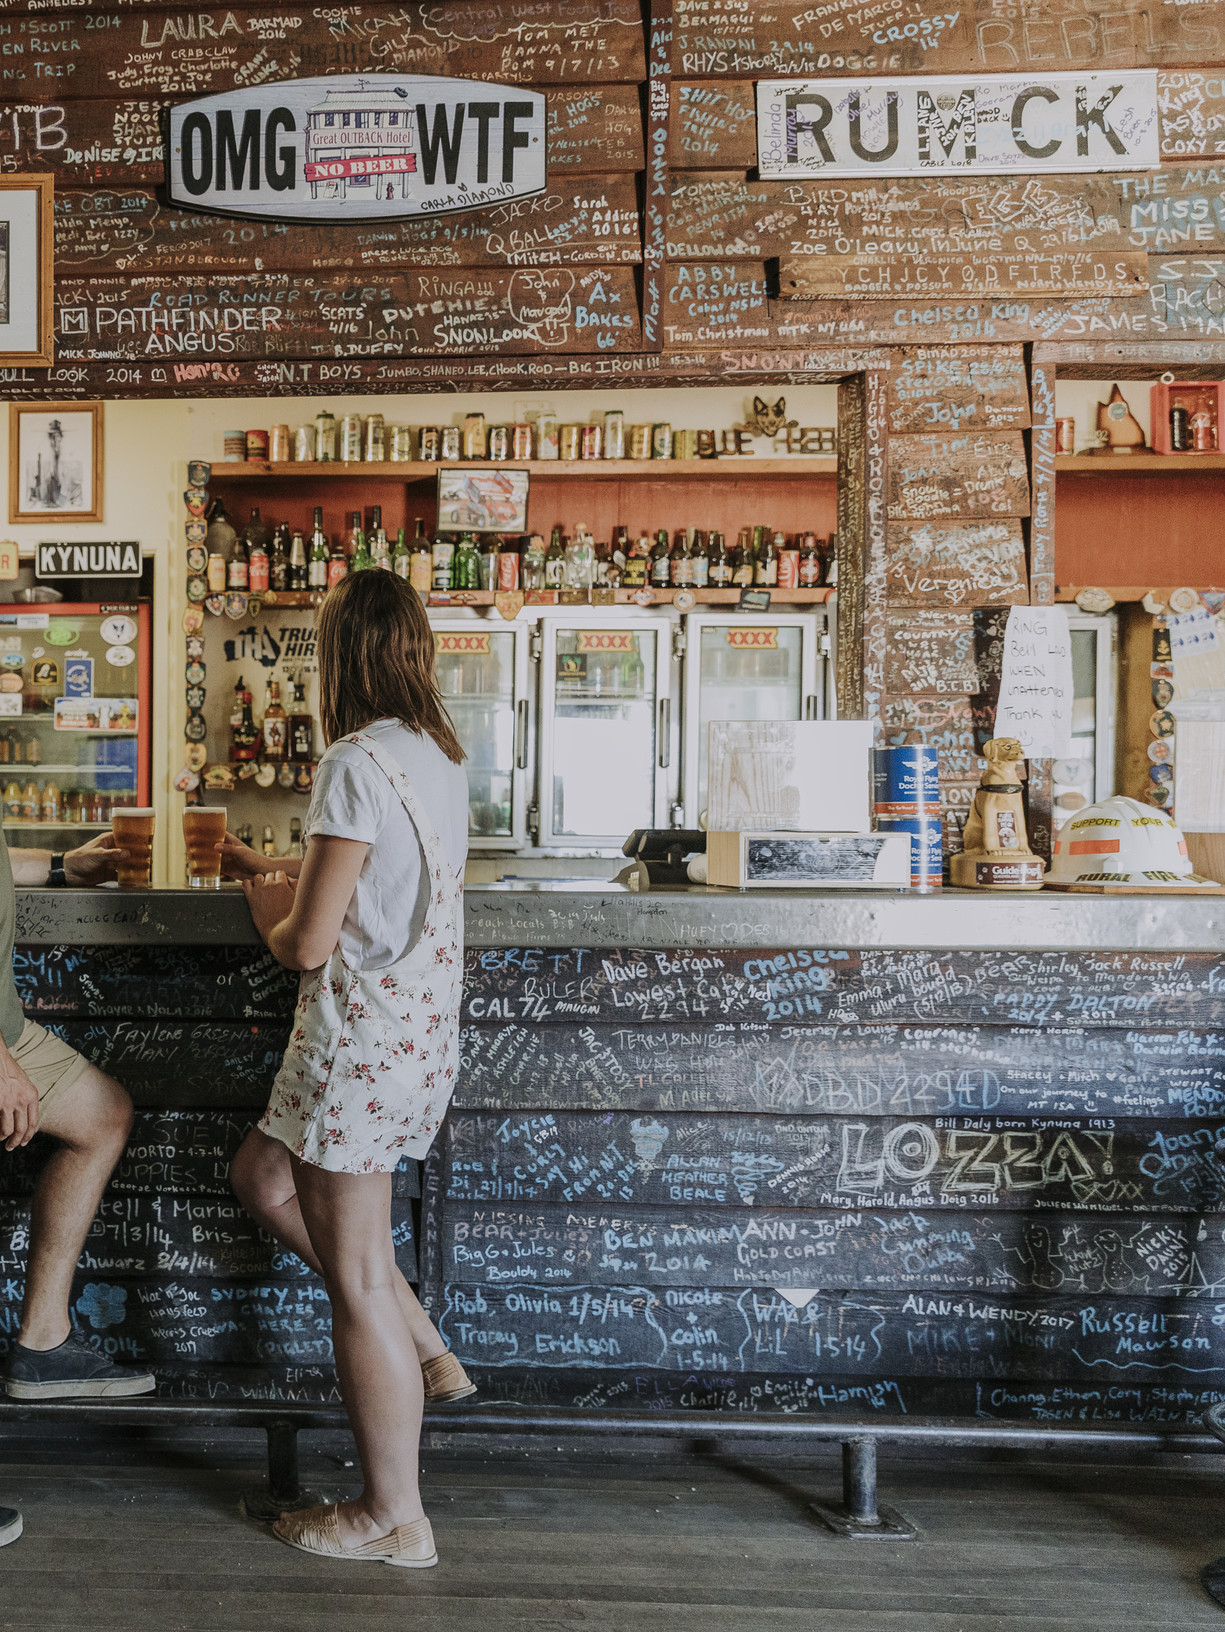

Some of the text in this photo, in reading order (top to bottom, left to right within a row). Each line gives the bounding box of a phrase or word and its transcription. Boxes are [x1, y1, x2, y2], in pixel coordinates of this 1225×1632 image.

[140, 11, 244, 49] LAURA
[247, 17, 302, 32] BARMAID
[564, 24, 600, 39] MET
[872, 11, 961, 46] CROSSY
[30, 38, 81, 52] RIVER
[572, 38, 607, 52] THE
[33, 60, 77, 78] TRIP
[313, 129, 411, 146] Great OUTBACK Hotel
[416, 101, 534, 185] WTF
[181, 106, 297, 195] OMG
[314, 156, 409, 178] NO BEER
[420, 181, 516, 211] CARLA DIAMOND
[1128, 222, 1216, 249] JANE
[96, 306, 282, 333] PATHFINDER
[892, 301, 1031, 328] Chelsea King
[1063, 311, 1171, 337] JAMES
[144, 332, 236, 353] ANGUS
[106, 368, 143, 383] 2014
[697, 429, 755, 458] BLUE
[40, 545, 138, 572] KYNUNA
[1014, 617, 1047, 635] RING
[441, 636, 485, 650] XXXX
[583, 634, 628, 648] XXXX
[727, 631, 773, 645] XXXX
[285, 643, 316, 656] HIR
[1010, 664, 1045, 677] WHEN
[1071, 818, 1121, 830] SUPPORT
[992, 866, 1019, 874] Guide
[1076, 871, 1181, 882] RURAL FIRE
[601, 958, 648, 984] Dave
[612, 985, 688, 1008] Lowest
[1065, 993, 1155, 1011] DALTON
[468, 998, 516, 1018] CAL
[935, 1117, 1116, 1131] Bill Daly born Kynuna 1913
[820, 1192, 999, 1209] Mary, Harold, Angus Doig 2016
[505, 1292, 561, 1313] Olivia
[901, 1294, 1074, 1330] ALAN 2017
[1080, 1306, 1168, 1336] Russell
[535, 1334, 621, 1356] Erickson
[1116, 1336, 1212, 1355] Mawson
